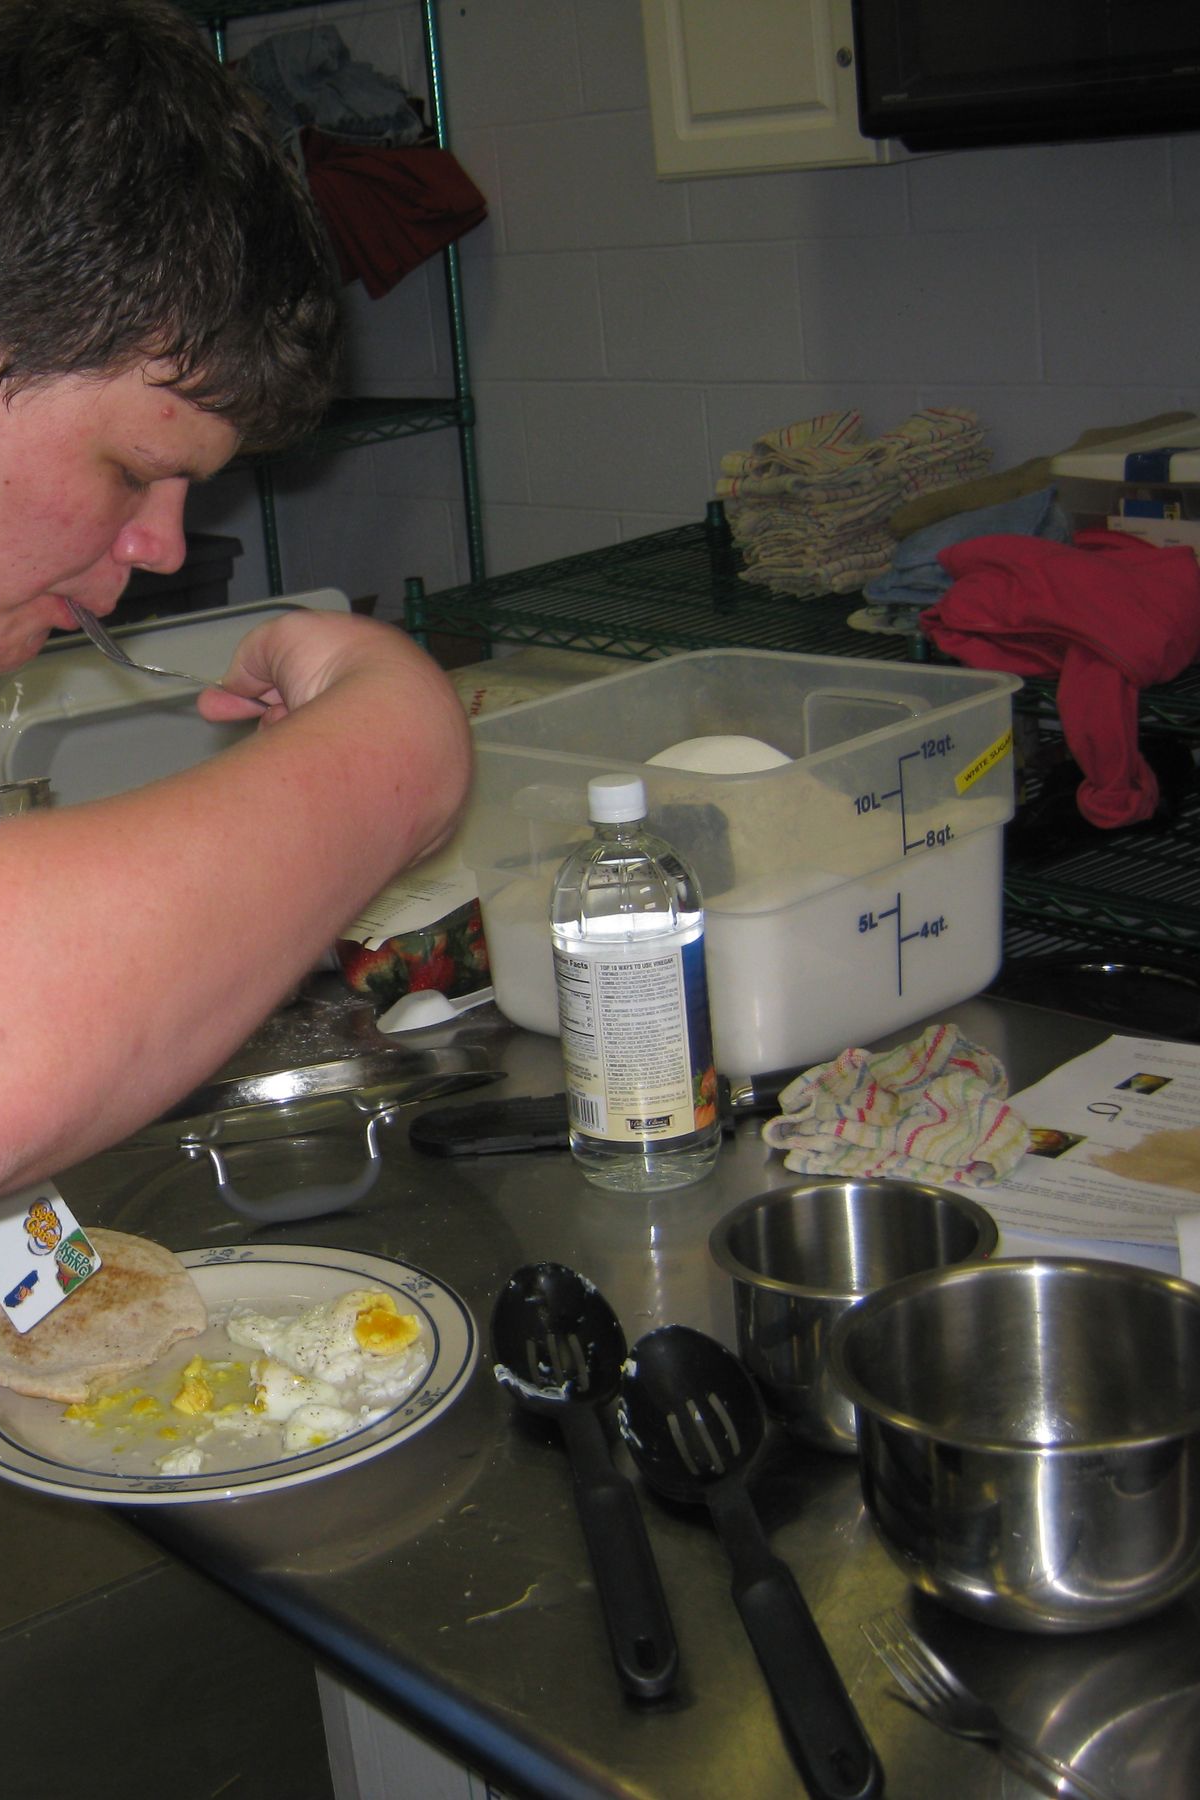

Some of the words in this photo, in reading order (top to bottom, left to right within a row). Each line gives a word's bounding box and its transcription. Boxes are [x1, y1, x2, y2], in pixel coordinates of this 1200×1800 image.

[920, 734, 955, 759] 12qt.
[964, 758, 989, 783] WHITE
[854, 792, 881, 816] 10L
[925, 824, 955, 848] 8qt.
[858, 912, 878, 934] 5L
[920, 915, 949, 939] 4qt.
[569, 959, 589, 970] Facts
[653, 957, 674, 968] VINEGAR
[55, 1247, 90, 1278] GOING
[60, 1240, 91, 1266] KEEP
